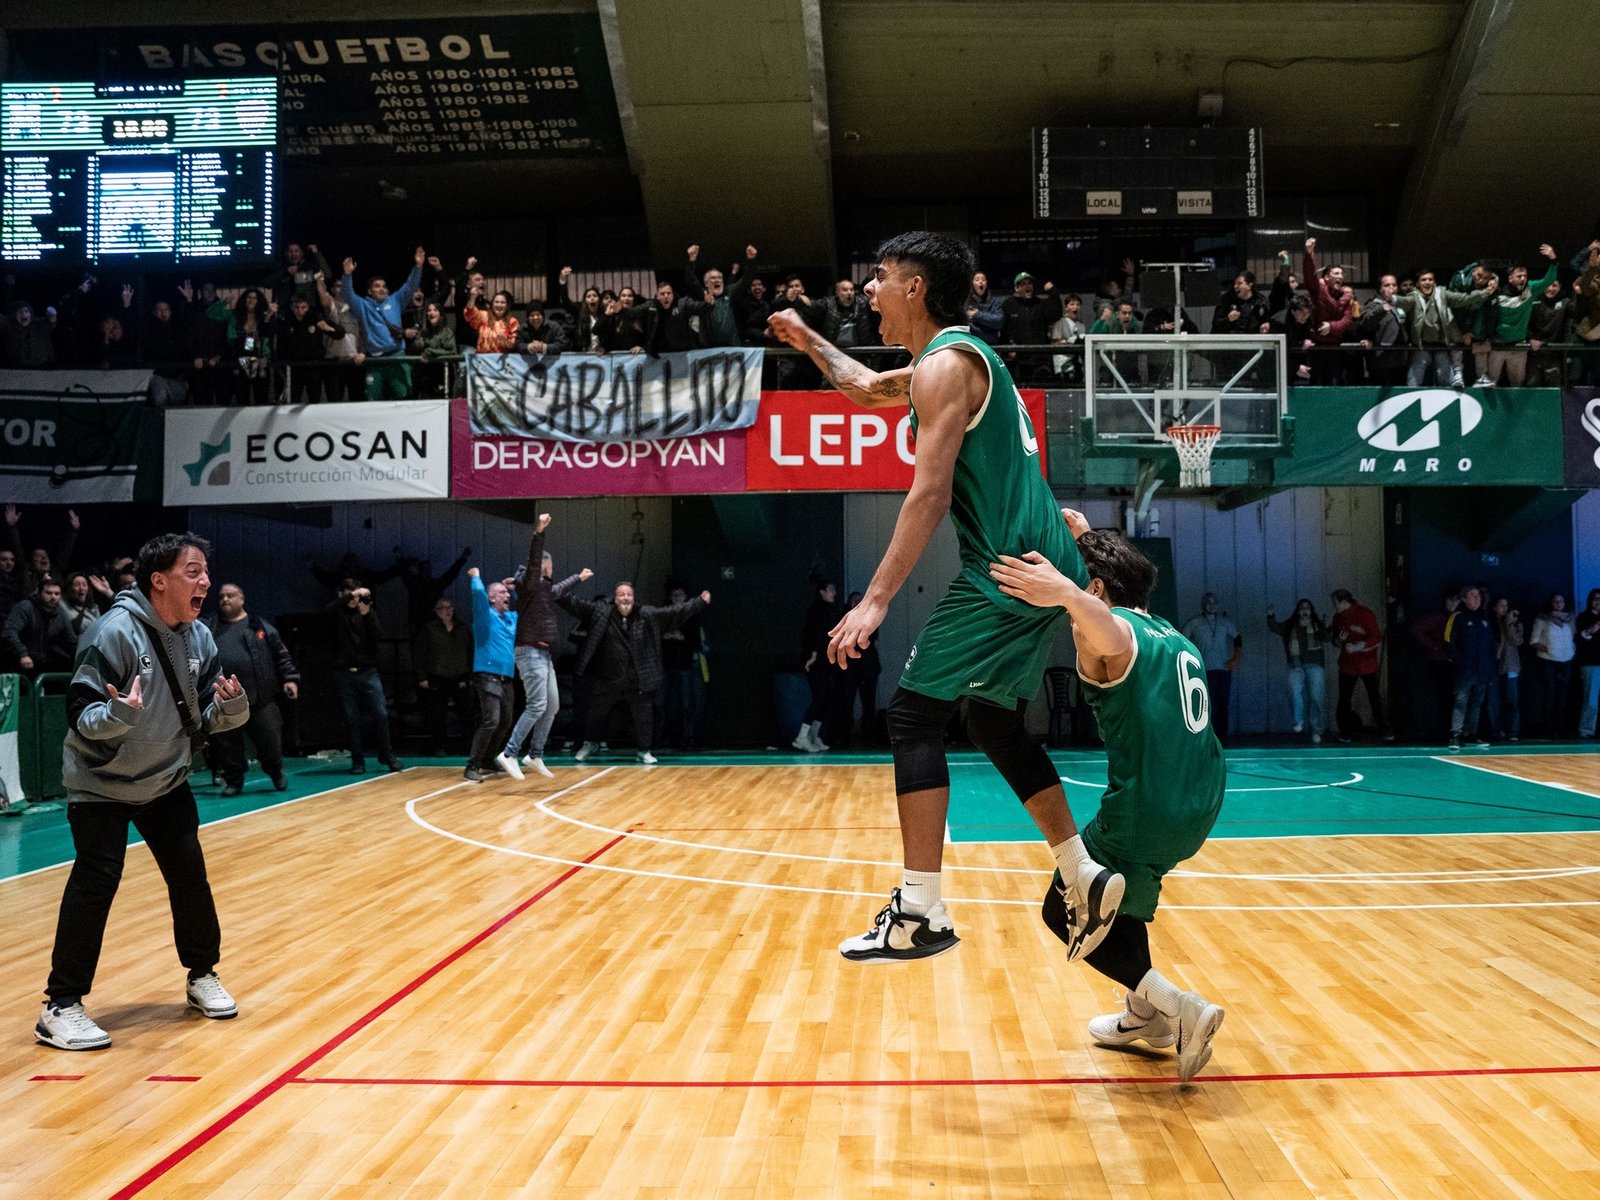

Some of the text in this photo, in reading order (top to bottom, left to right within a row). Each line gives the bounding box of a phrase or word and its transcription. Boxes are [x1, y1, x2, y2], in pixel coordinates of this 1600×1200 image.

[138, 34, 511, 71] BASQUETBOL
[370, 69, 419, 82] AÑOS
[374, 83, 424, 95] AÑOS
[379, 96, 428, 109] AÑOS
[1087, 198, 1121, 208] LOCAL
[1177, 198, 1212, 208] VISITA
[519, 351, 747, 437] CABALLITO
[246, 430, 427, 463] ECOSAN
[473, 438, 725, 469] DERAGOPYAN
[1358, 457, 1473, 473] MARO
[246, 466, 428, 485] Construcción Modular
[1176, 650, 1209, 734] 6
